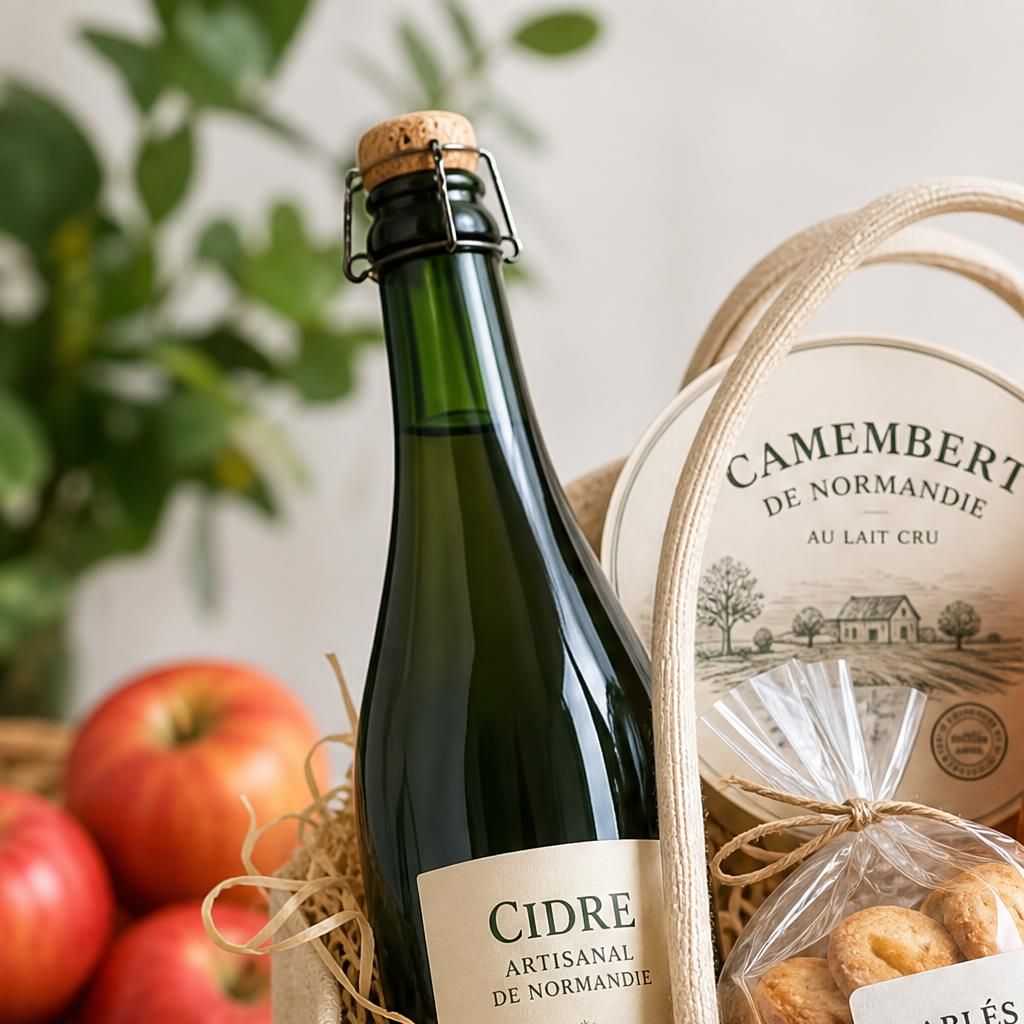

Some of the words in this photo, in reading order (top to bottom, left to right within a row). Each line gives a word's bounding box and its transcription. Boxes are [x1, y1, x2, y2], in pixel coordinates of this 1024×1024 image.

[763, 488, 801, 517] DE
[810, 474, 988, 519] NORMANDIE
[807, 530, 834, 545] AU
[844, 530, 889, 545] LAIT
[897, 530, 939, 545] CRU
[489, 892, 636, 944] CIDRE
[505, 944, 634, 978] ARTISANAL
[492, 987, 521, 1007] DE
[529, 969, 653, 1000] NORMANDIE
